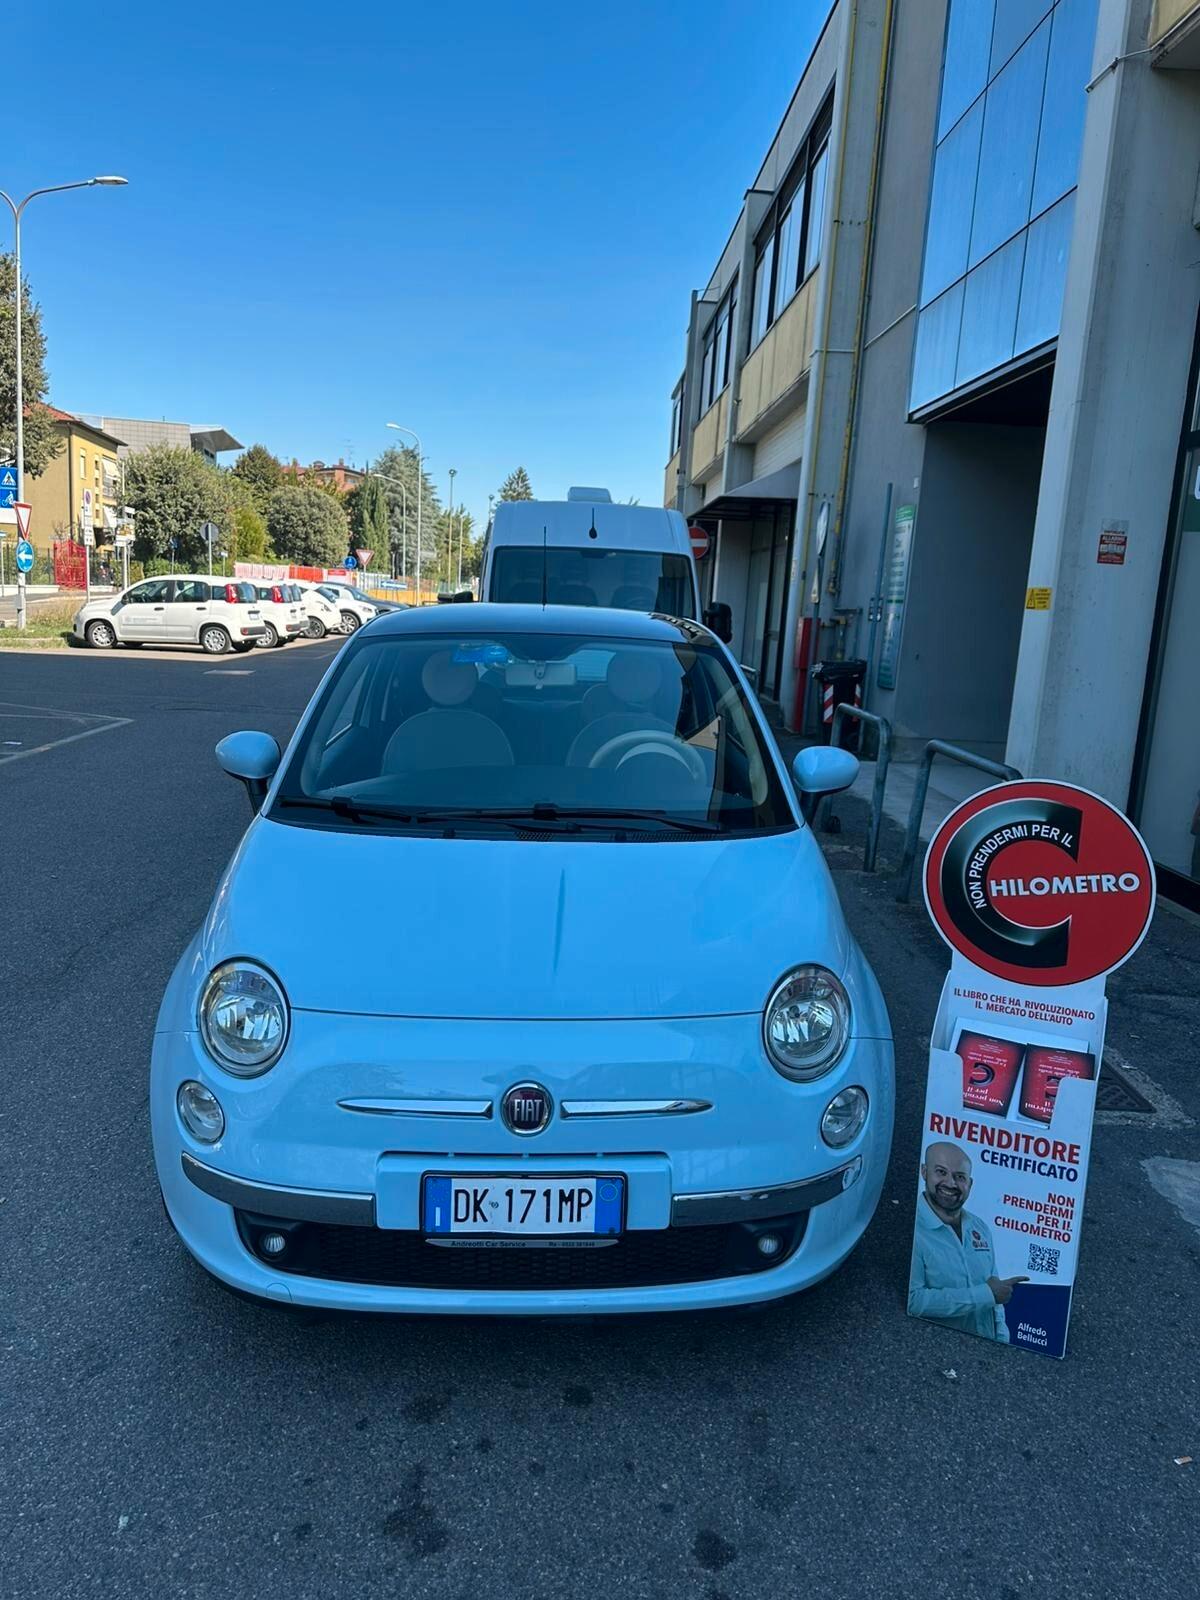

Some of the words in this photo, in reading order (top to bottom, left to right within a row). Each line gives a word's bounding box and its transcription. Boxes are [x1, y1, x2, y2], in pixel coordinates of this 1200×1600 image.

[1032, 824, 1060, 840] PER
[1061, 832, 1073, 848] IL
[969, 824, 1028, 878] PRENDERMI
[969, 881, 987, 909] NON
[954, 988, 962, 997] IL
[963, 989, 988, 1001] LIBRO
[990, 994, 1007, 1004] CHE
[1008, 998, 1021, 1007] HA
[1024, 1000, 1096, 1021] RIVOLUZIONATO
[975, 1001, 983, 1010] IL
[986, 1002, 1027, 1017] MERCATO
[1028, 1010, 1073, 1026] DELL'AUTO
[512, 1099, 542, 1122] FIAT
[929, 1112, 1081, 1165] RIVENDITORE
[980, 1149, 1079, 1183] CERTIFICATO
[454, 1188, 490, 1223] DK
[505, 1188, 593, 1224] 171MP
[1003, 1194, 1074, 1220] PRENDERMI
[1047, 1192, 1075, 1208] NON
[994, 1215, 1071, 1243] CHILOMETRO
[1036, 1214, 1059, 1229] PER
[1062, 1220, 1073, 1232] IL
[485, 1240, 499, 1248] Car
[500, 1240, 527, 1248] Service
[1017, 1322, 1047, 1337] Alfredo
[1017, 1331, 1048, 1347] Bellucci
